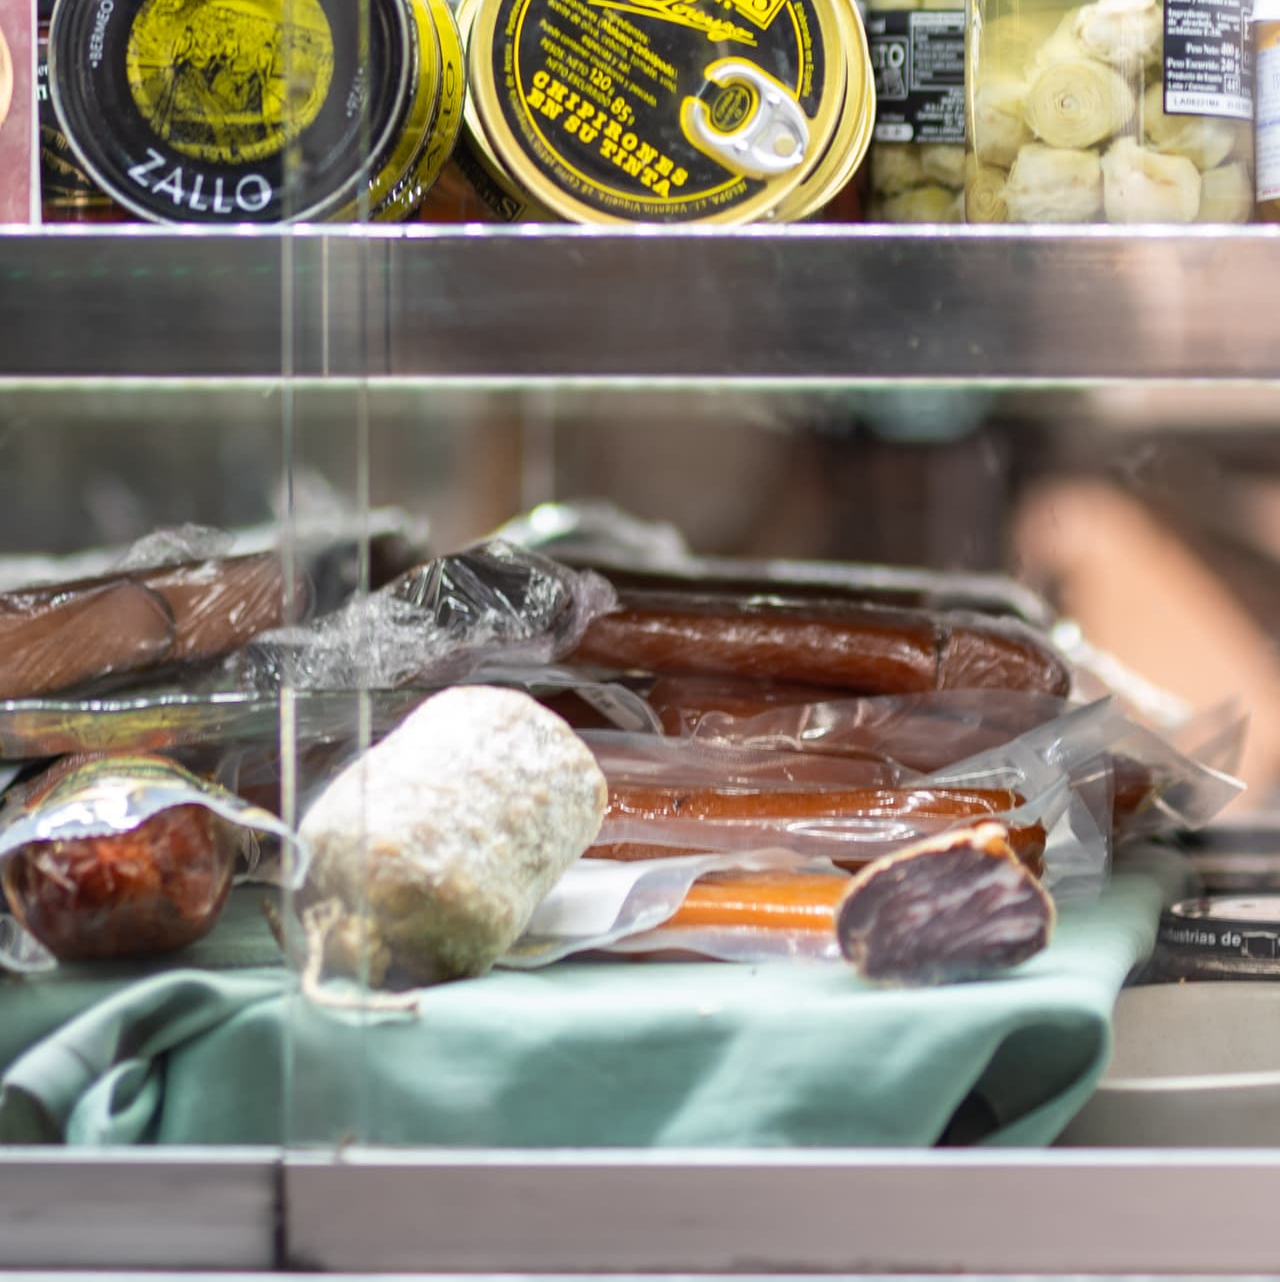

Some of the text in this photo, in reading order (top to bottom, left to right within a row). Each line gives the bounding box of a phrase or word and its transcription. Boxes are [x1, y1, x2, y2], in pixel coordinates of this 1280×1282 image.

[526, 87, 671, 199] EN SU TINTA
[532, 69, 689, 188] CHIPIRONES
[127, 148, 273, 215] ZALLO
[1220, 929, 1242, 945] de
